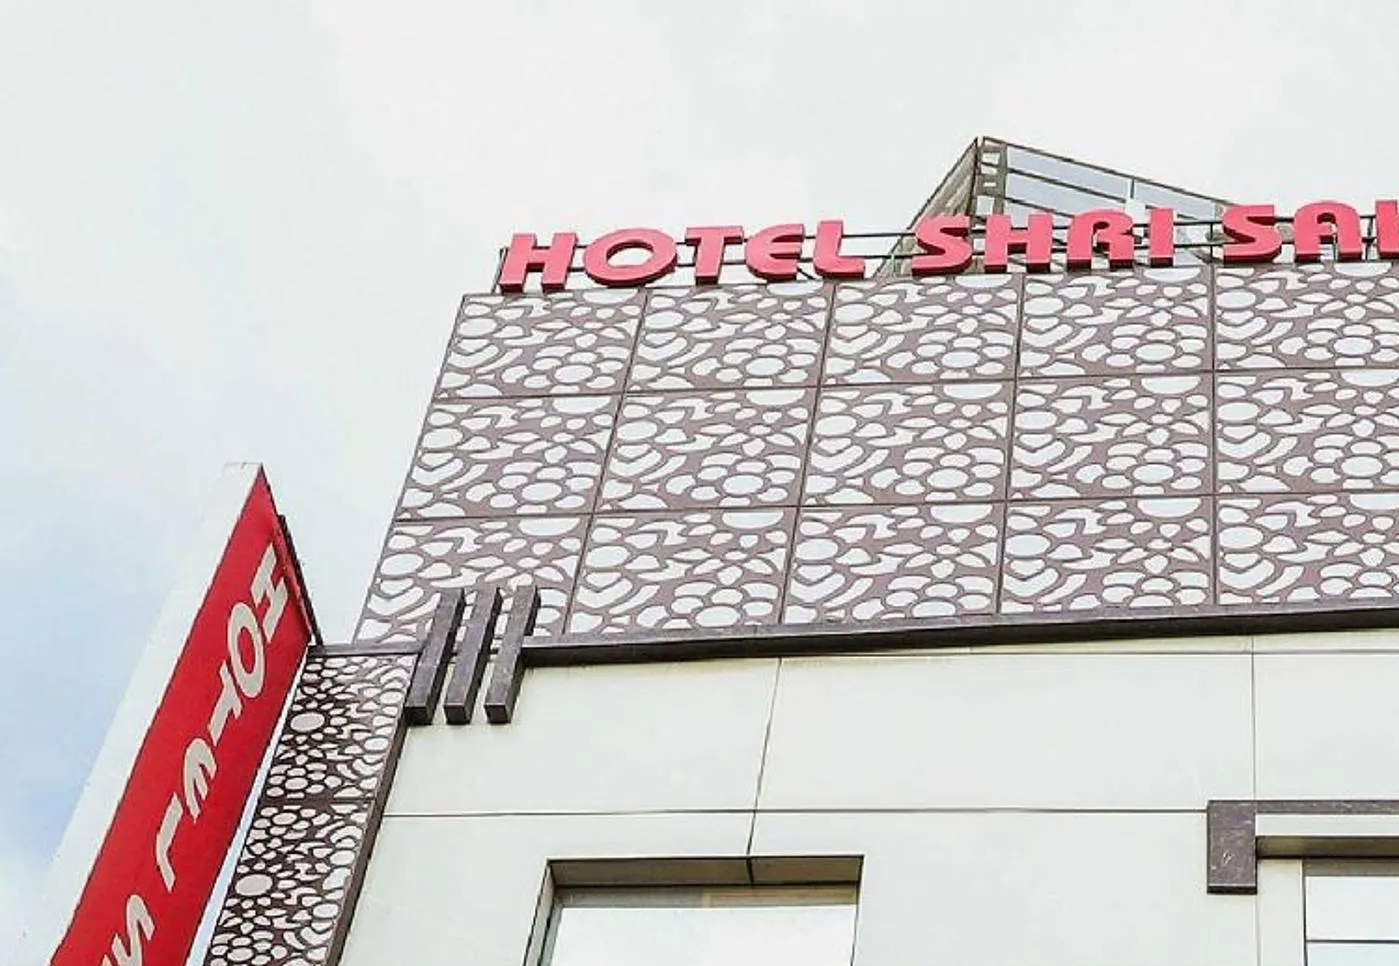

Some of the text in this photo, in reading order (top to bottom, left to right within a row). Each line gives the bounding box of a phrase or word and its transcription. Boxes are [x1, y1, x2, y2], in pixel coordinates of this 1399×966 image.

[499, 219, 865, 293] HOTEL
[911, 207, 1174, 276] SHRI
[155, 541, 289, 893] HOTEL
